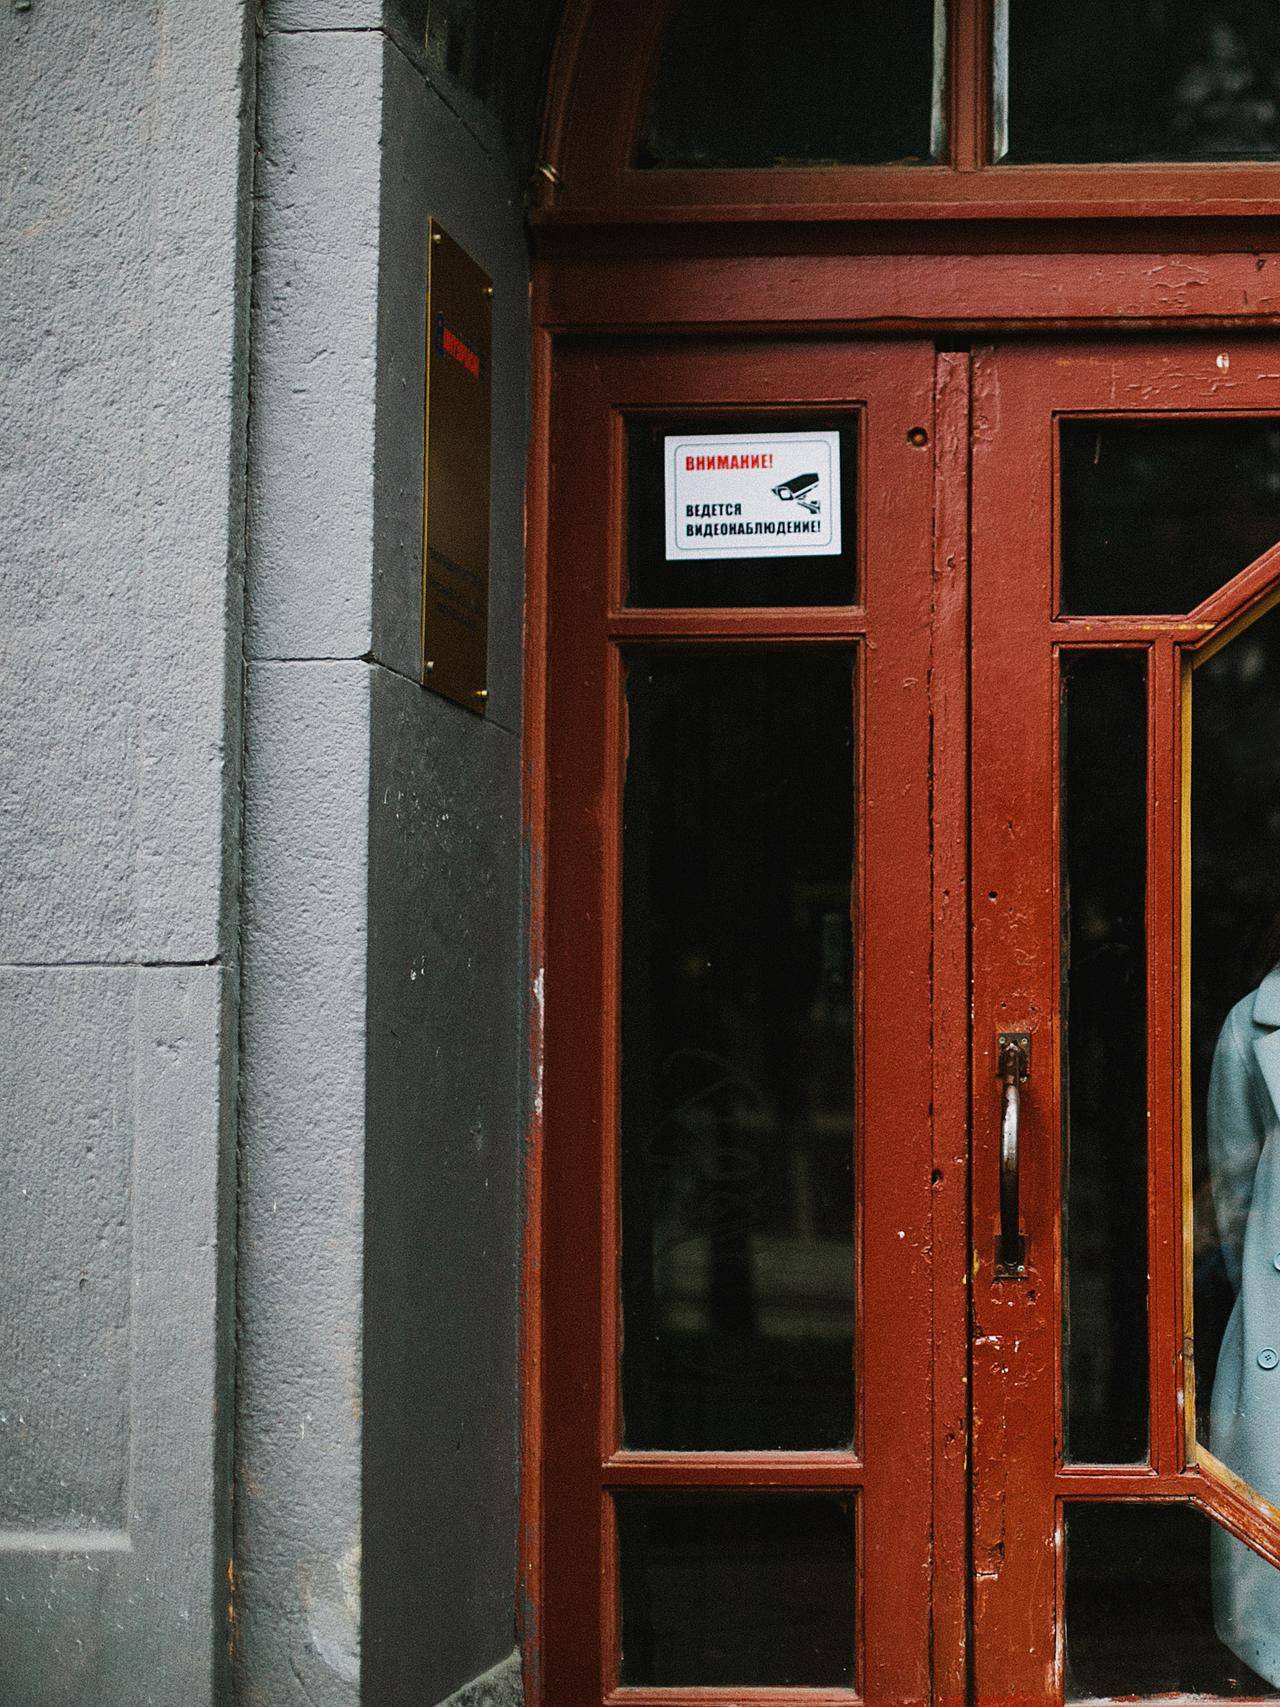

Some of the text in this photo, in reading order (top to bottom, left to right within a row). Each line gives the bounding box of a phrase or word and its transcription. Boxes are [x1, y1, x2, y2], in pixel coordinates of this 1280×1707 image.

[685, 454, 773, 471] ВНИМАНИЕ!
[686, 503, 742, 518] ВЕДЕТСЯ
[686, 520, 821, 538] ВИДЕОНАБЛЮДЕНИЕ!
